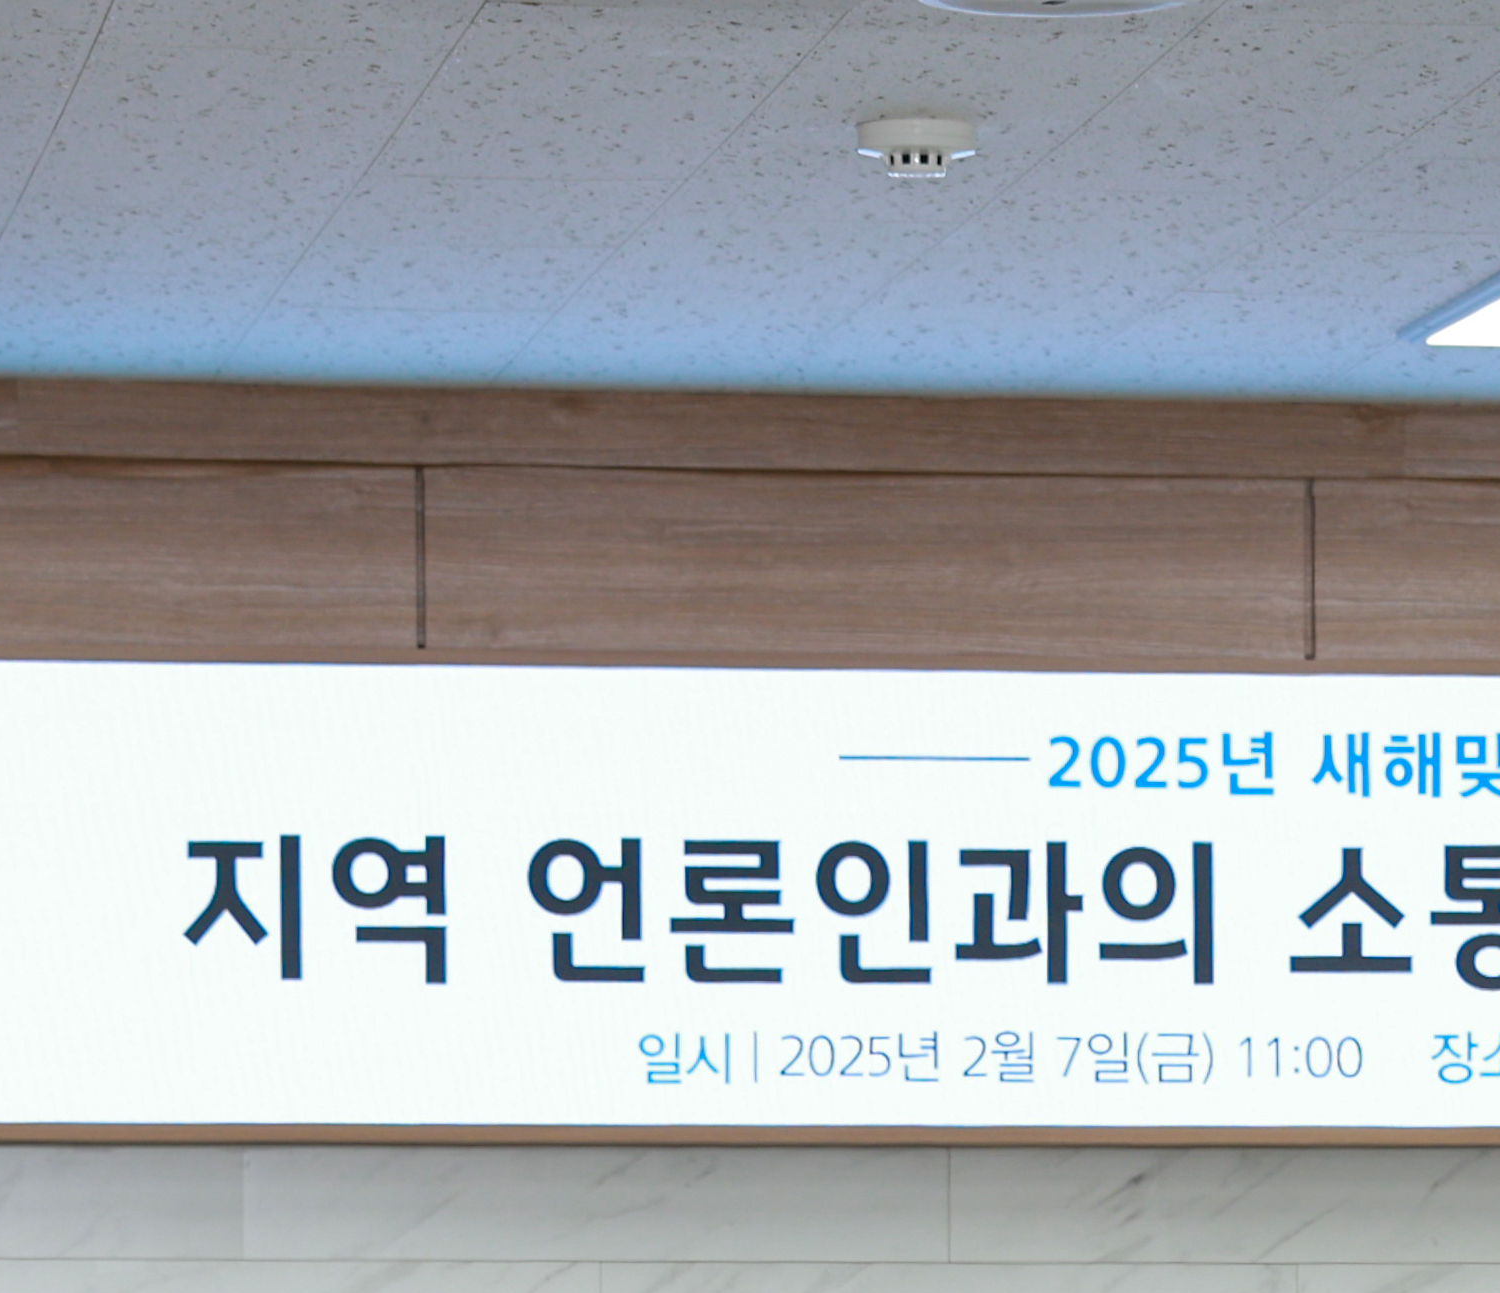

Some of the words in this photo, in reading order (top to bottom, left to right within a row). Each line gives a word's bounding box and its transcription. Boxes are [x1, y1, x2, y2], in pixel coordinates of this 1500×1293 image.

[1048, 730, 1275, 797] 2025년
[182, 833, 448, 986] 지역
[526, 836, 1215, 986] 언론인과의
[638, 1032, 732, 1085] 일시
[778, 1030, 940, 1084] 2025년
[961, 1030, 1035, 1084] 2월
[1056, 1030, 1215, 1085] 7일(금)
[1239, 1035, 1365, 1079] 11:00
